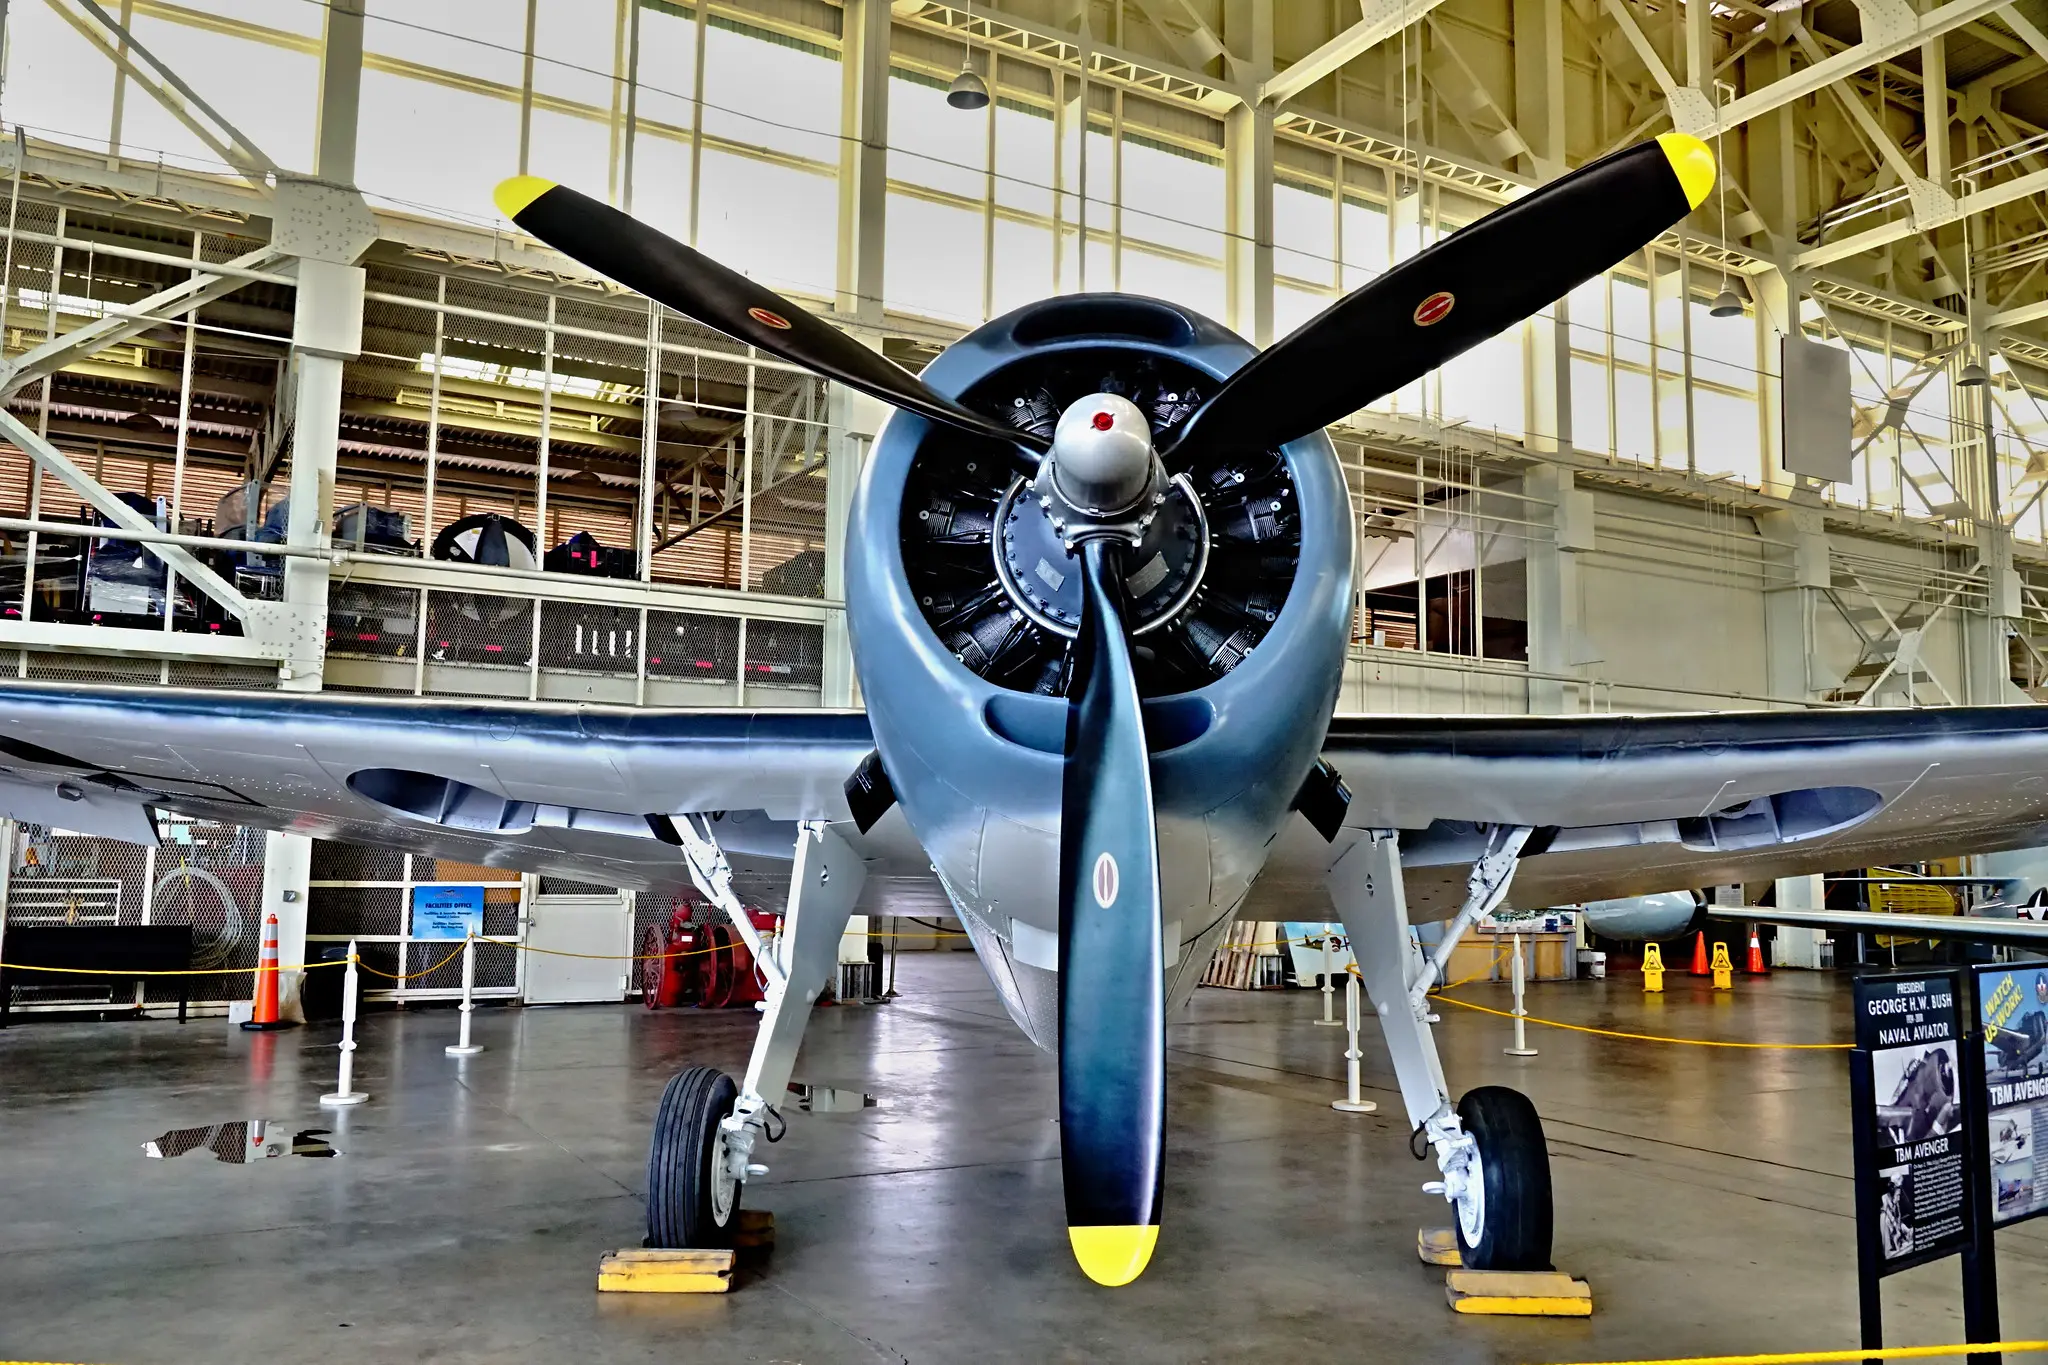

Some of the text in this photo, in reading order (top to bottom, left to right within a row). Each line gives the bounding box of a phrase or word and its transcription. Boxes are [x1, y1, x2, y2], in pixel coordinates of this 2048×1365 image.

[1896, 981, 1926, 994] PRESIDENT
[1985, 972, 2013, 1017] WATCH
[1868, 993, 1952, 1016] GEORGE H.W. BUSH
[1985, 984, 2023, 1043] US WORK!
[1879, 1021, 1950, 1045] NAVAL AVIATOR
[1990, 1084, 2013, 1106] TBM
[1894, 1137, 1949, 1163] TBM AVENGER
